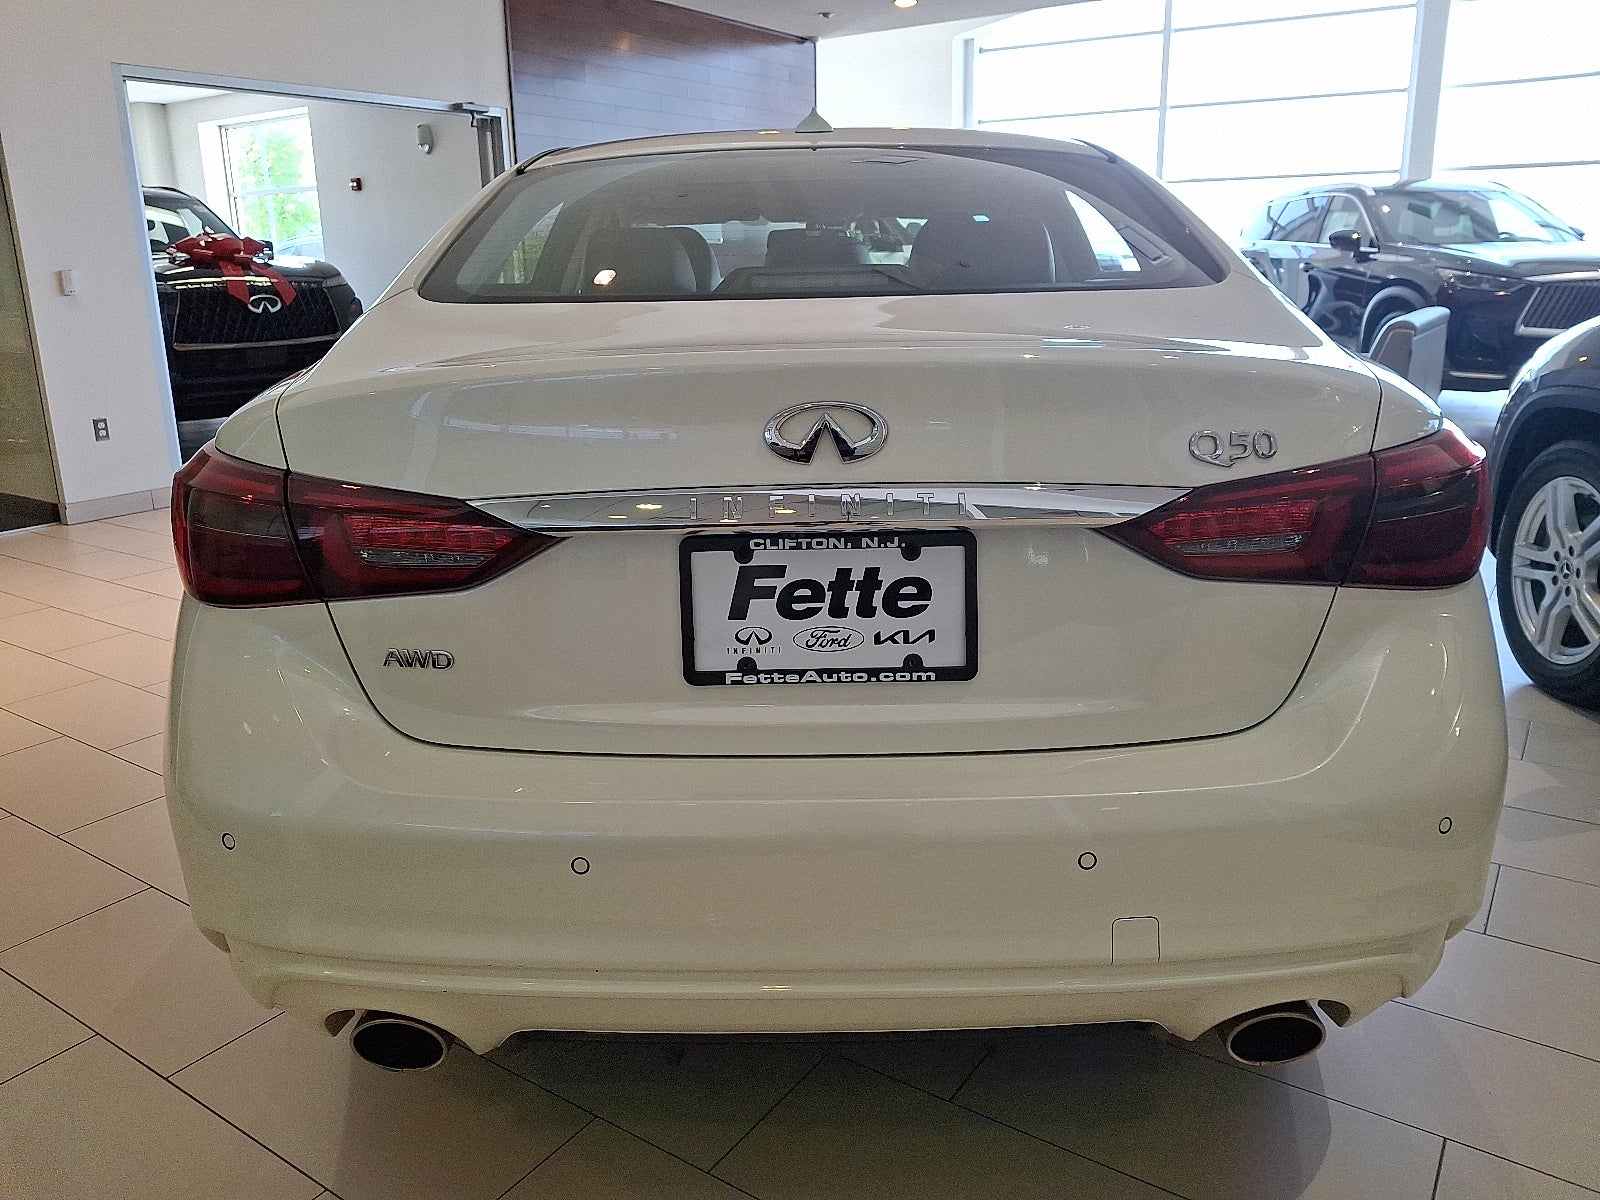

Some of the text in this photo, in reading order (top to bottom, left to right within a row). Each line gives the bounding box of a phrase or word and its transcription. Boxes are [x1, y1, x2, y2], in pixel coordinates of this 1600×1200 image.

[1188, 430, 1278, 467] Q50
[689, 492, 967, 520] INFINITI
[750, 536, 906, 551] CLIFTON, N.J.
[728, 564, 932, 620] Fette
[382, 648, 455, 670] AWD
[727, 646, 781, 655] INFINITI
[725, 671, 936, 685] FetteAuto.com
